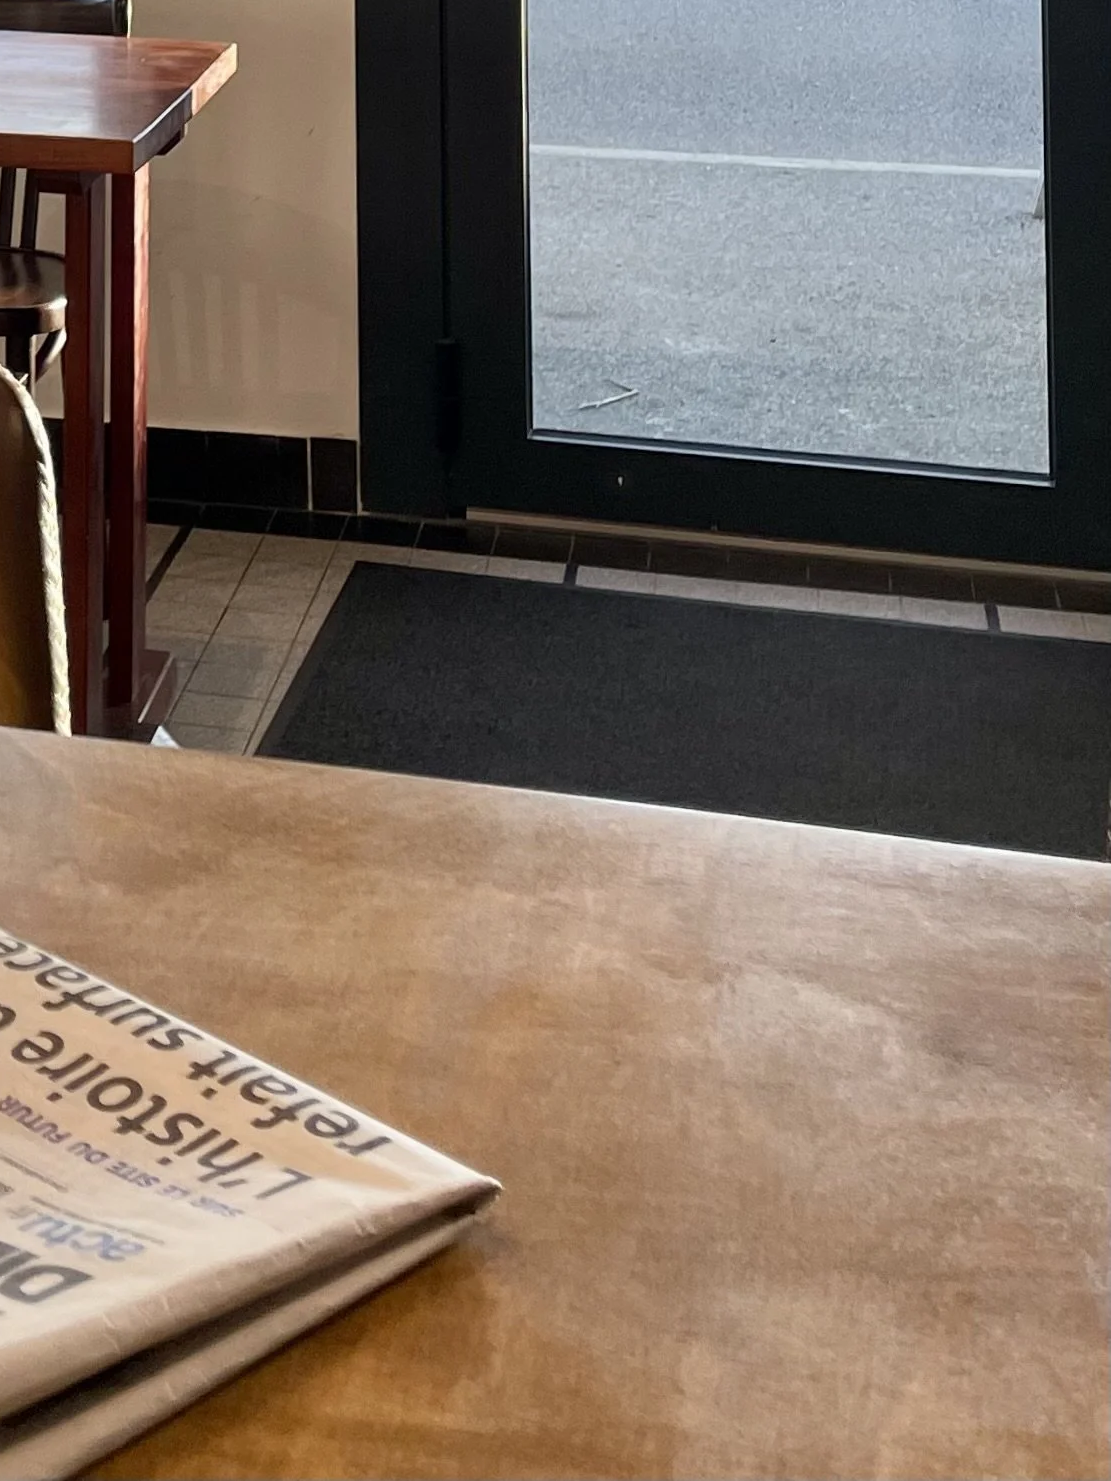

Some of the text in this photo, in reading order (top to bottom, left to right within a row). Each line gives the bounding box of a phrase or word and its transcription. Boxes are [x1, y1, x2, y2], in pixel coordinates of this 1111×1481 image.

[10, 1029, 313, 1201] L'histoire
[185, 1049, 393, 1157] refait
[68, 1141, 111, 1165] DU
[106, 1161, 161, 1189] SITE
